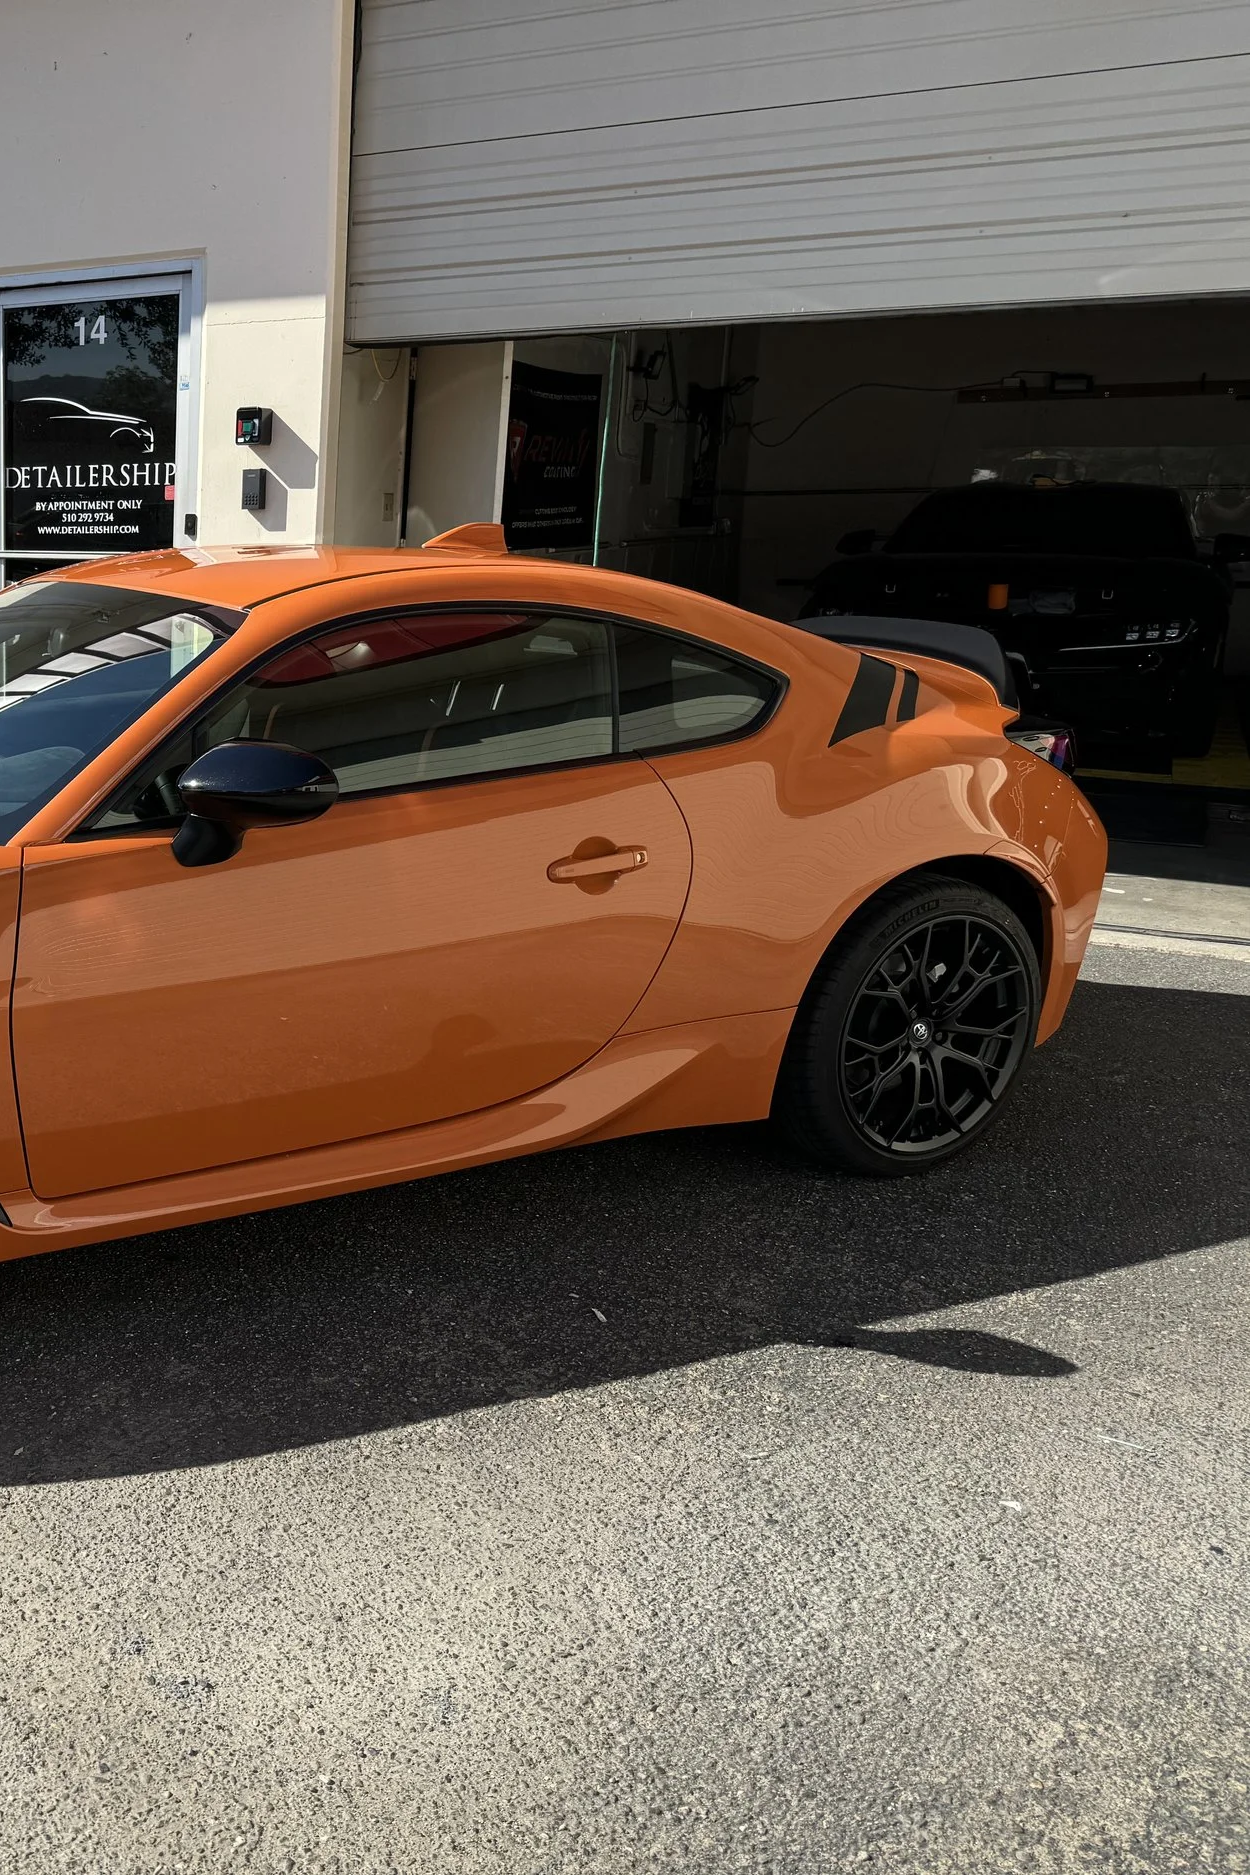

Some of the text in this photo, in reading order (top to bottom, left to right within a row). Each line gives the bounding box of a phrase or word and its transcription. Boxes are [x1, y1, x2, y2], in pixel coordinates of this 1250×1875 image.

[73, 314, 108, 346] 14
[6, 463, 177, 488] DETAILERSHIP
[35, 499, 143, 511] BY APPOINTMENT ONLY
[61, 512, 114, 523] 510 292 9734
[37, 525, 140, 535] WWW.DETAILERSHIP.COM
[884, 899, 939, 937] MICHELIN
